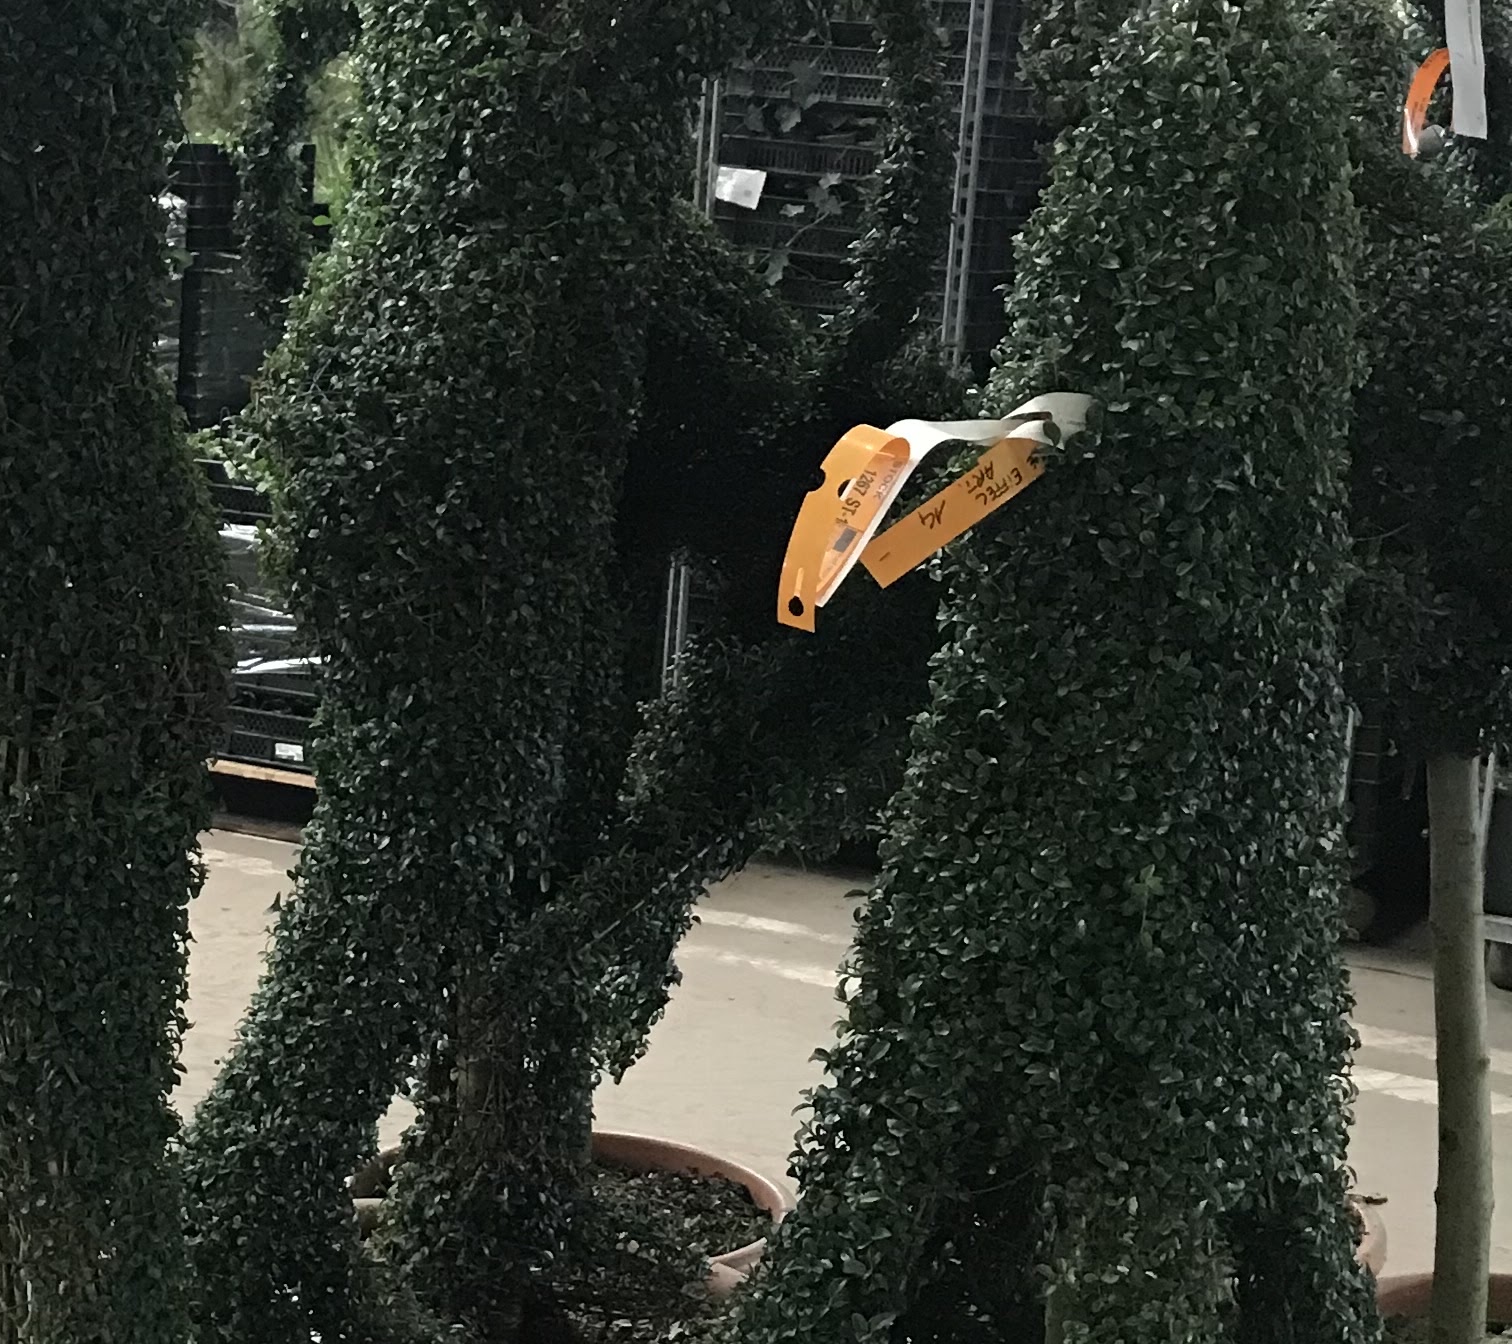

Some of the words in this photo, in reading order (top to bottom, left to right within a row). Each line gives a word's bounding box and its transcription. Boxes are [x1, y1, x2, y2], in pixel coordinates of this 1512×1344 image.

[855, 469, 878, 497] 1267
[873, 459, 903, 501] STOCK
[975, 467, 1023, 506] EIFFEL
